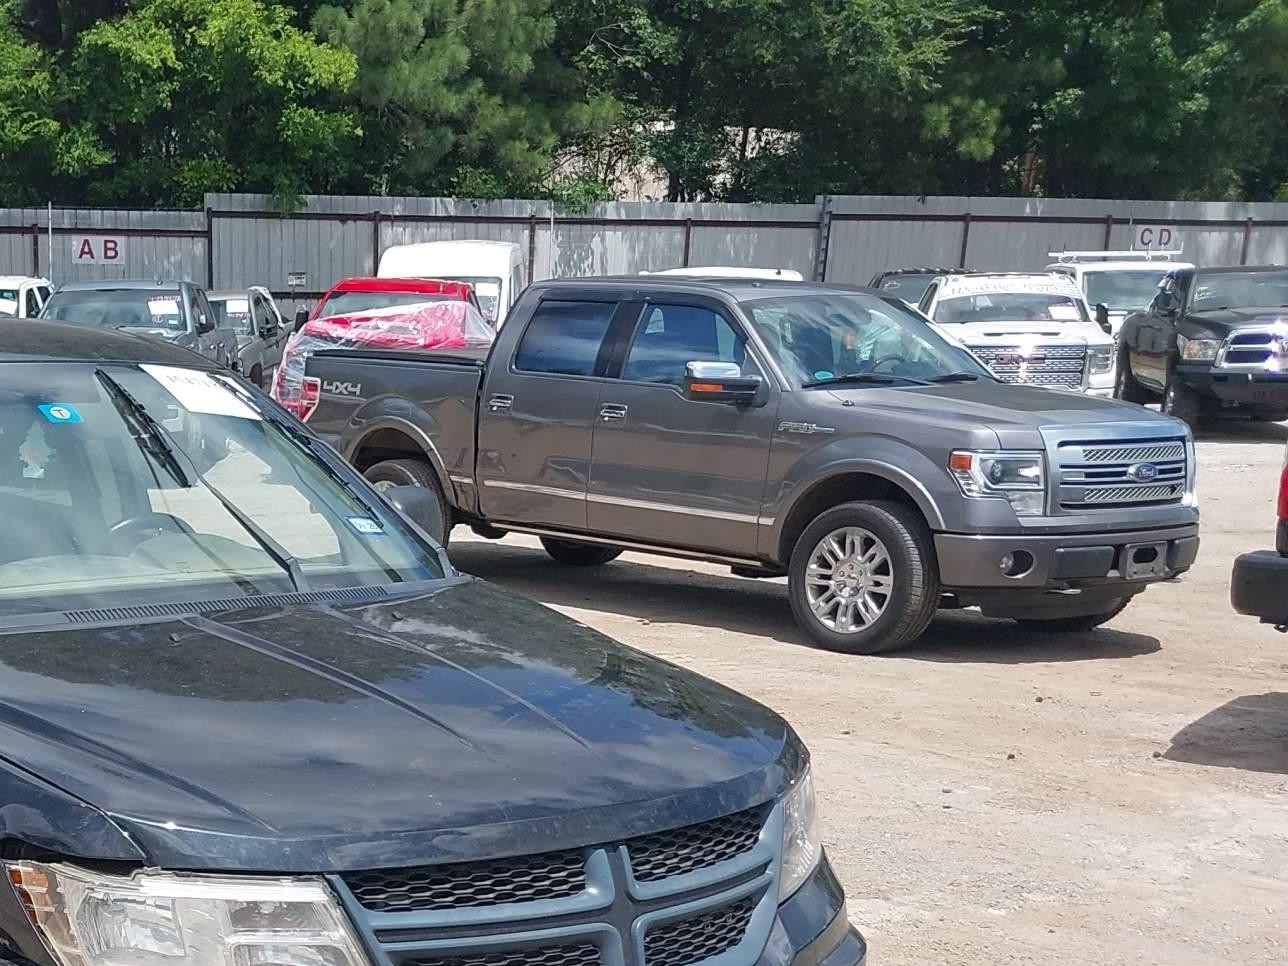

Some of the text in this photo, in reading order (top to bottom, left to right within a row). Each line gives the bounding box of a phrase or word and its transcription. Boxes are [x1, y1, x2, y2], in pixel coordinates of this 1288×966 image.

[1140, 227, 1172, 246] C D
[78, 238, 119, 260] A B
